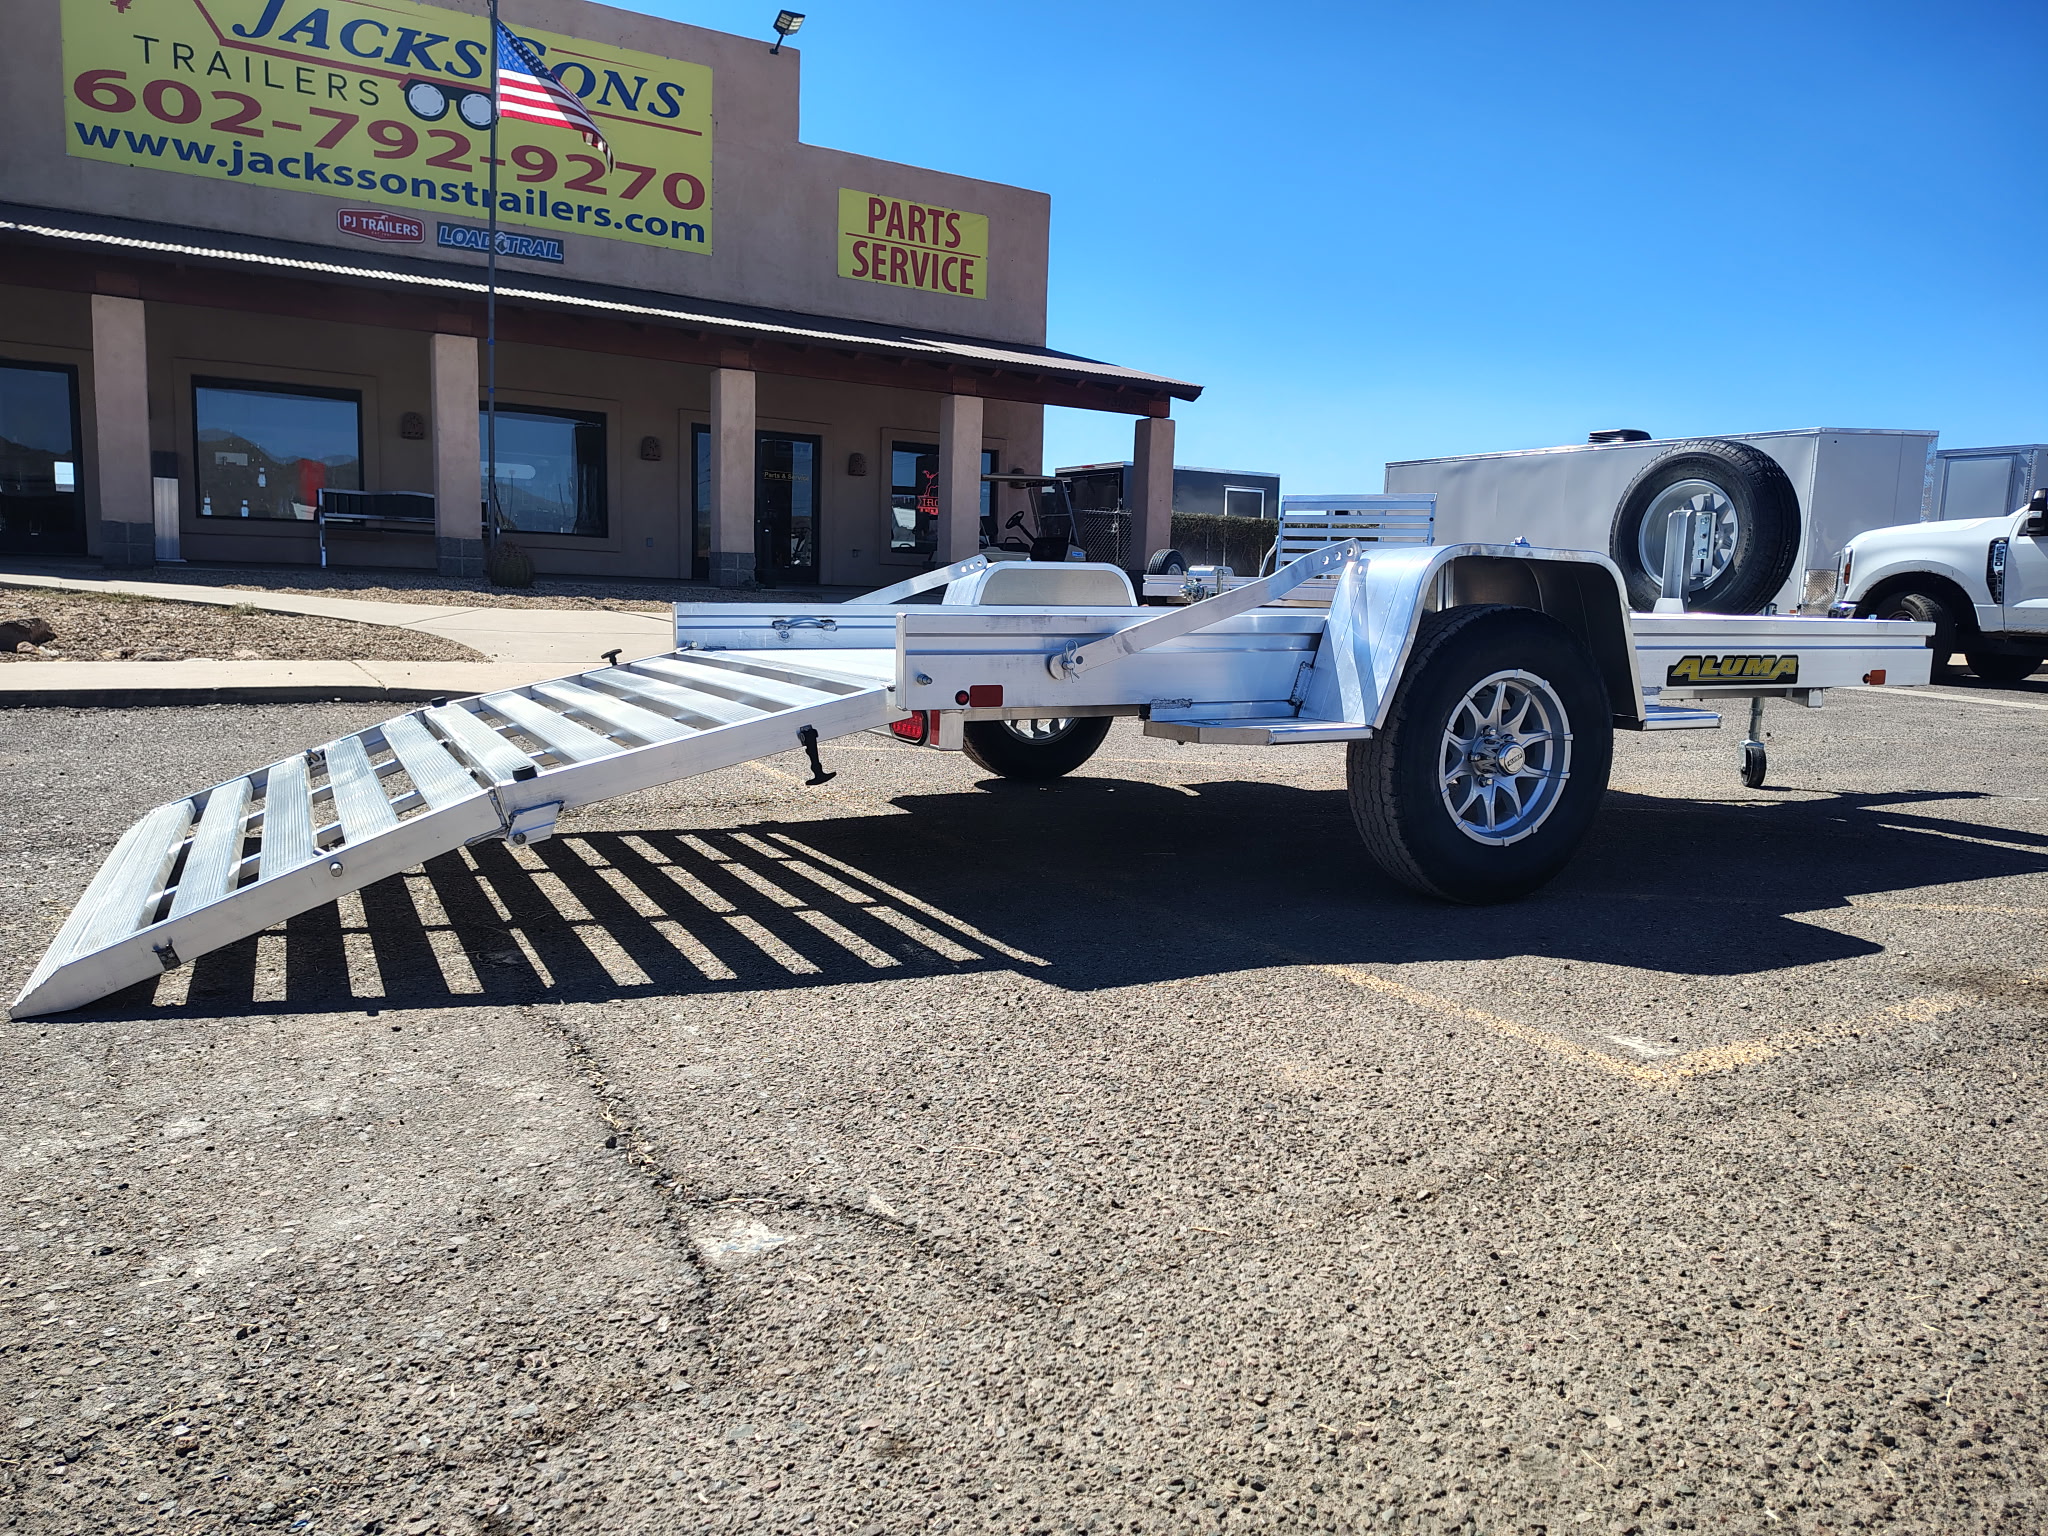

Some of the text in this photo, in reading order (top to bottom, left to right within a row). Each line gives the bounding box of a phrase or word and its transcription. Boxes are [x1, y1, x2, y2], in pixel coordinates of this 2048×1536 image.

[232, 0, 488, 80] JACKS
[133, 34, 380, 107] TRAILERS
[73, 69, 706, 211] 602-792-9270
[73, 121, 706, 244] www.jackssonstrailers.com
[343, 214, 420, 237] PJ TRAILERS
[439, 225, 563, 261] LOAD TRAIL
[867, 196, 962, 249] PARTS
[851, 240, 975, 296] SERVICE
[764, 471, 781, 479] Parts
[1670, 656, 1799, 682] ALUMA
